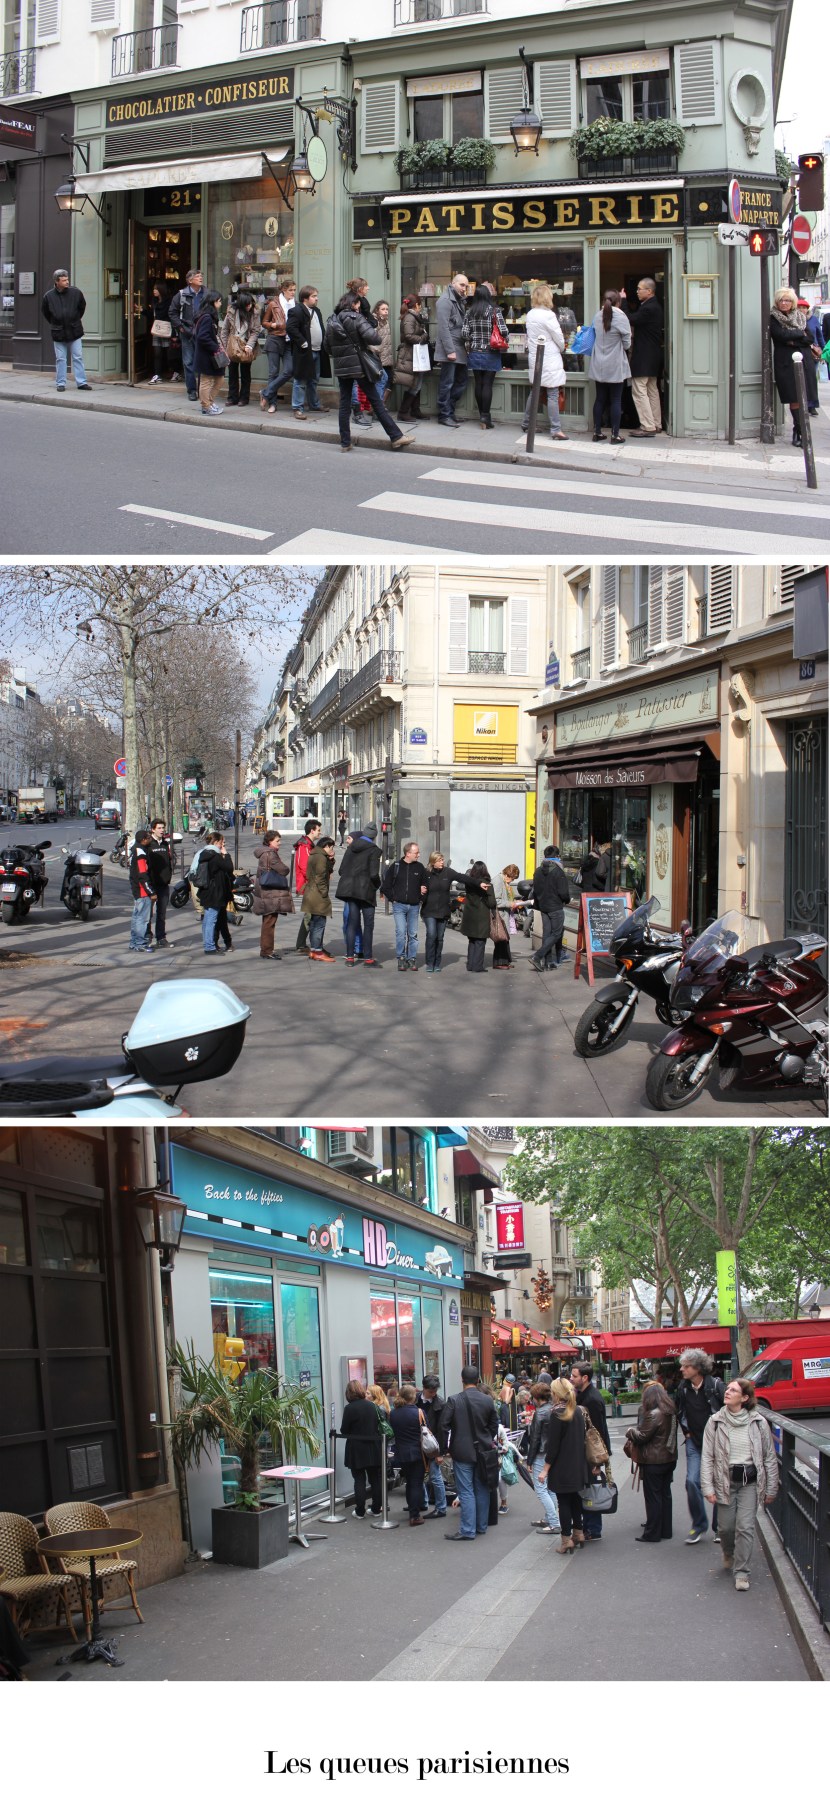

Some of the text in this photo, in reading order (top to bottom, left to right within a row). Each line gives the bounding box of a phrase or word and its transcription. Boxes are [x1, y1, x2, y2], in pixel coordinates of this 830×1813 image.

[109, 76, 290, 122] CHOCOLATIER CONFISEUR
[170, 190, 192, 207] 21
[740, 191, 772, 207] FRANCE
[389, 193, 680, 234] PATISSERIE
[801, 661, 813, 678] 86
[635, 688, 692, 719] Patissier
[475, 727, 497, 735] Nikon
[575, 768, 645, 785] Moisson des Saveurs
[494, 783, 524, 791] NIKON
[204, 1184, 284, 1206] Back to the fifties
[362, 1216, 415, 1269] HD Diner
